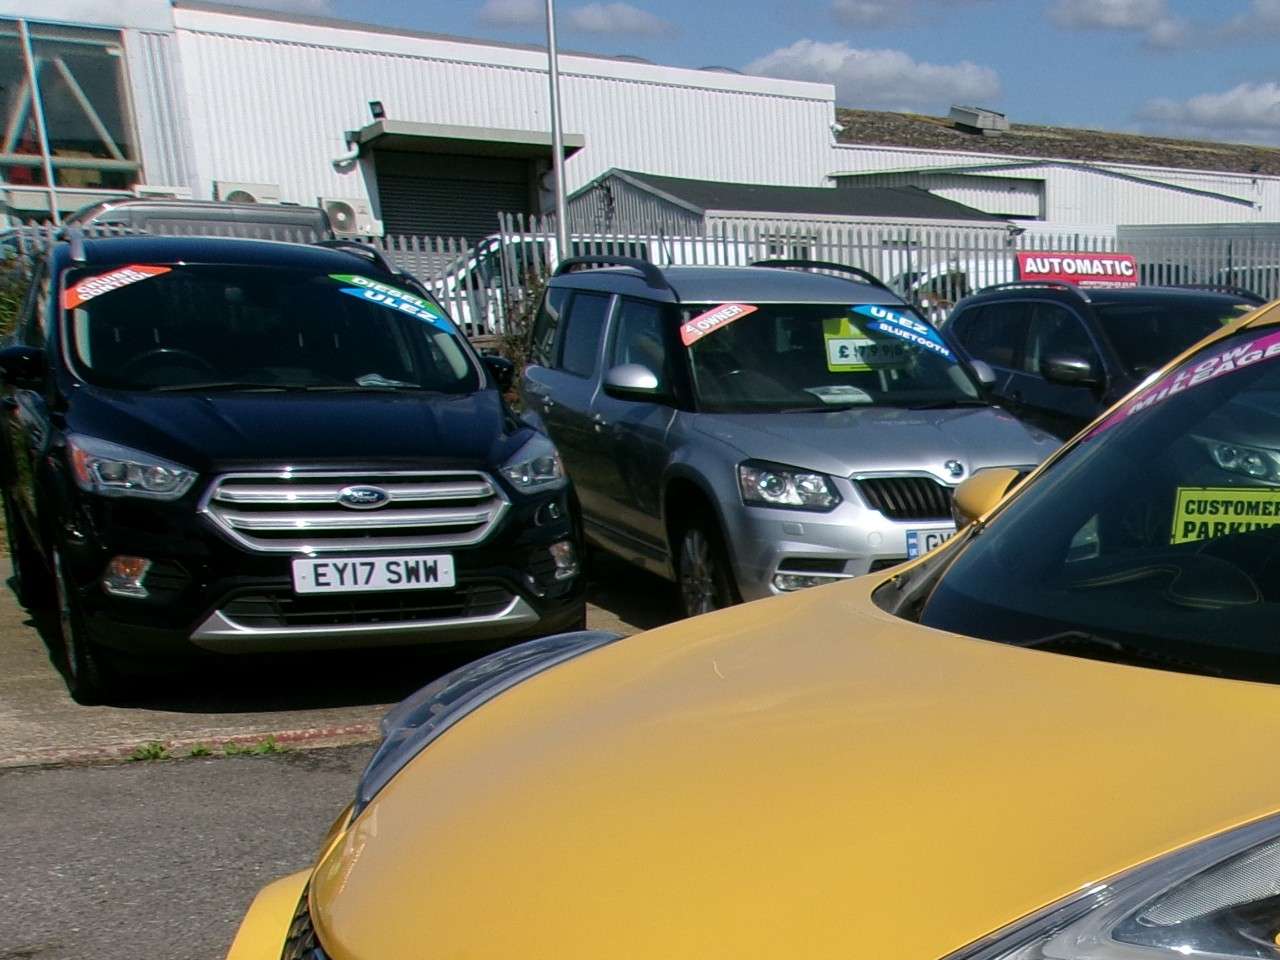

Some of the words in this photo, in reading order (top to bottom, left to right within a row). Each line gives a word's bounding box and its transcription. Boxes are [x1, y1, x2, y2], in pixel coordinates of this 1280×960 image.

[1025, 258, 1134, 276] AUTOMATIC
[352, 276, 425, 308] DIESEL
[364, 289, 438, 322] ULEZ
[697, 304, 743, 329] OWNER
[870, 306, 929, 335] ULEZ
[879, 323, 950, 357] BLUETOOTH
[1174, 342, 1253, 384] LOW
[313, 561, 376, 587] EY17
[385, 559, 439, 585] SWW
